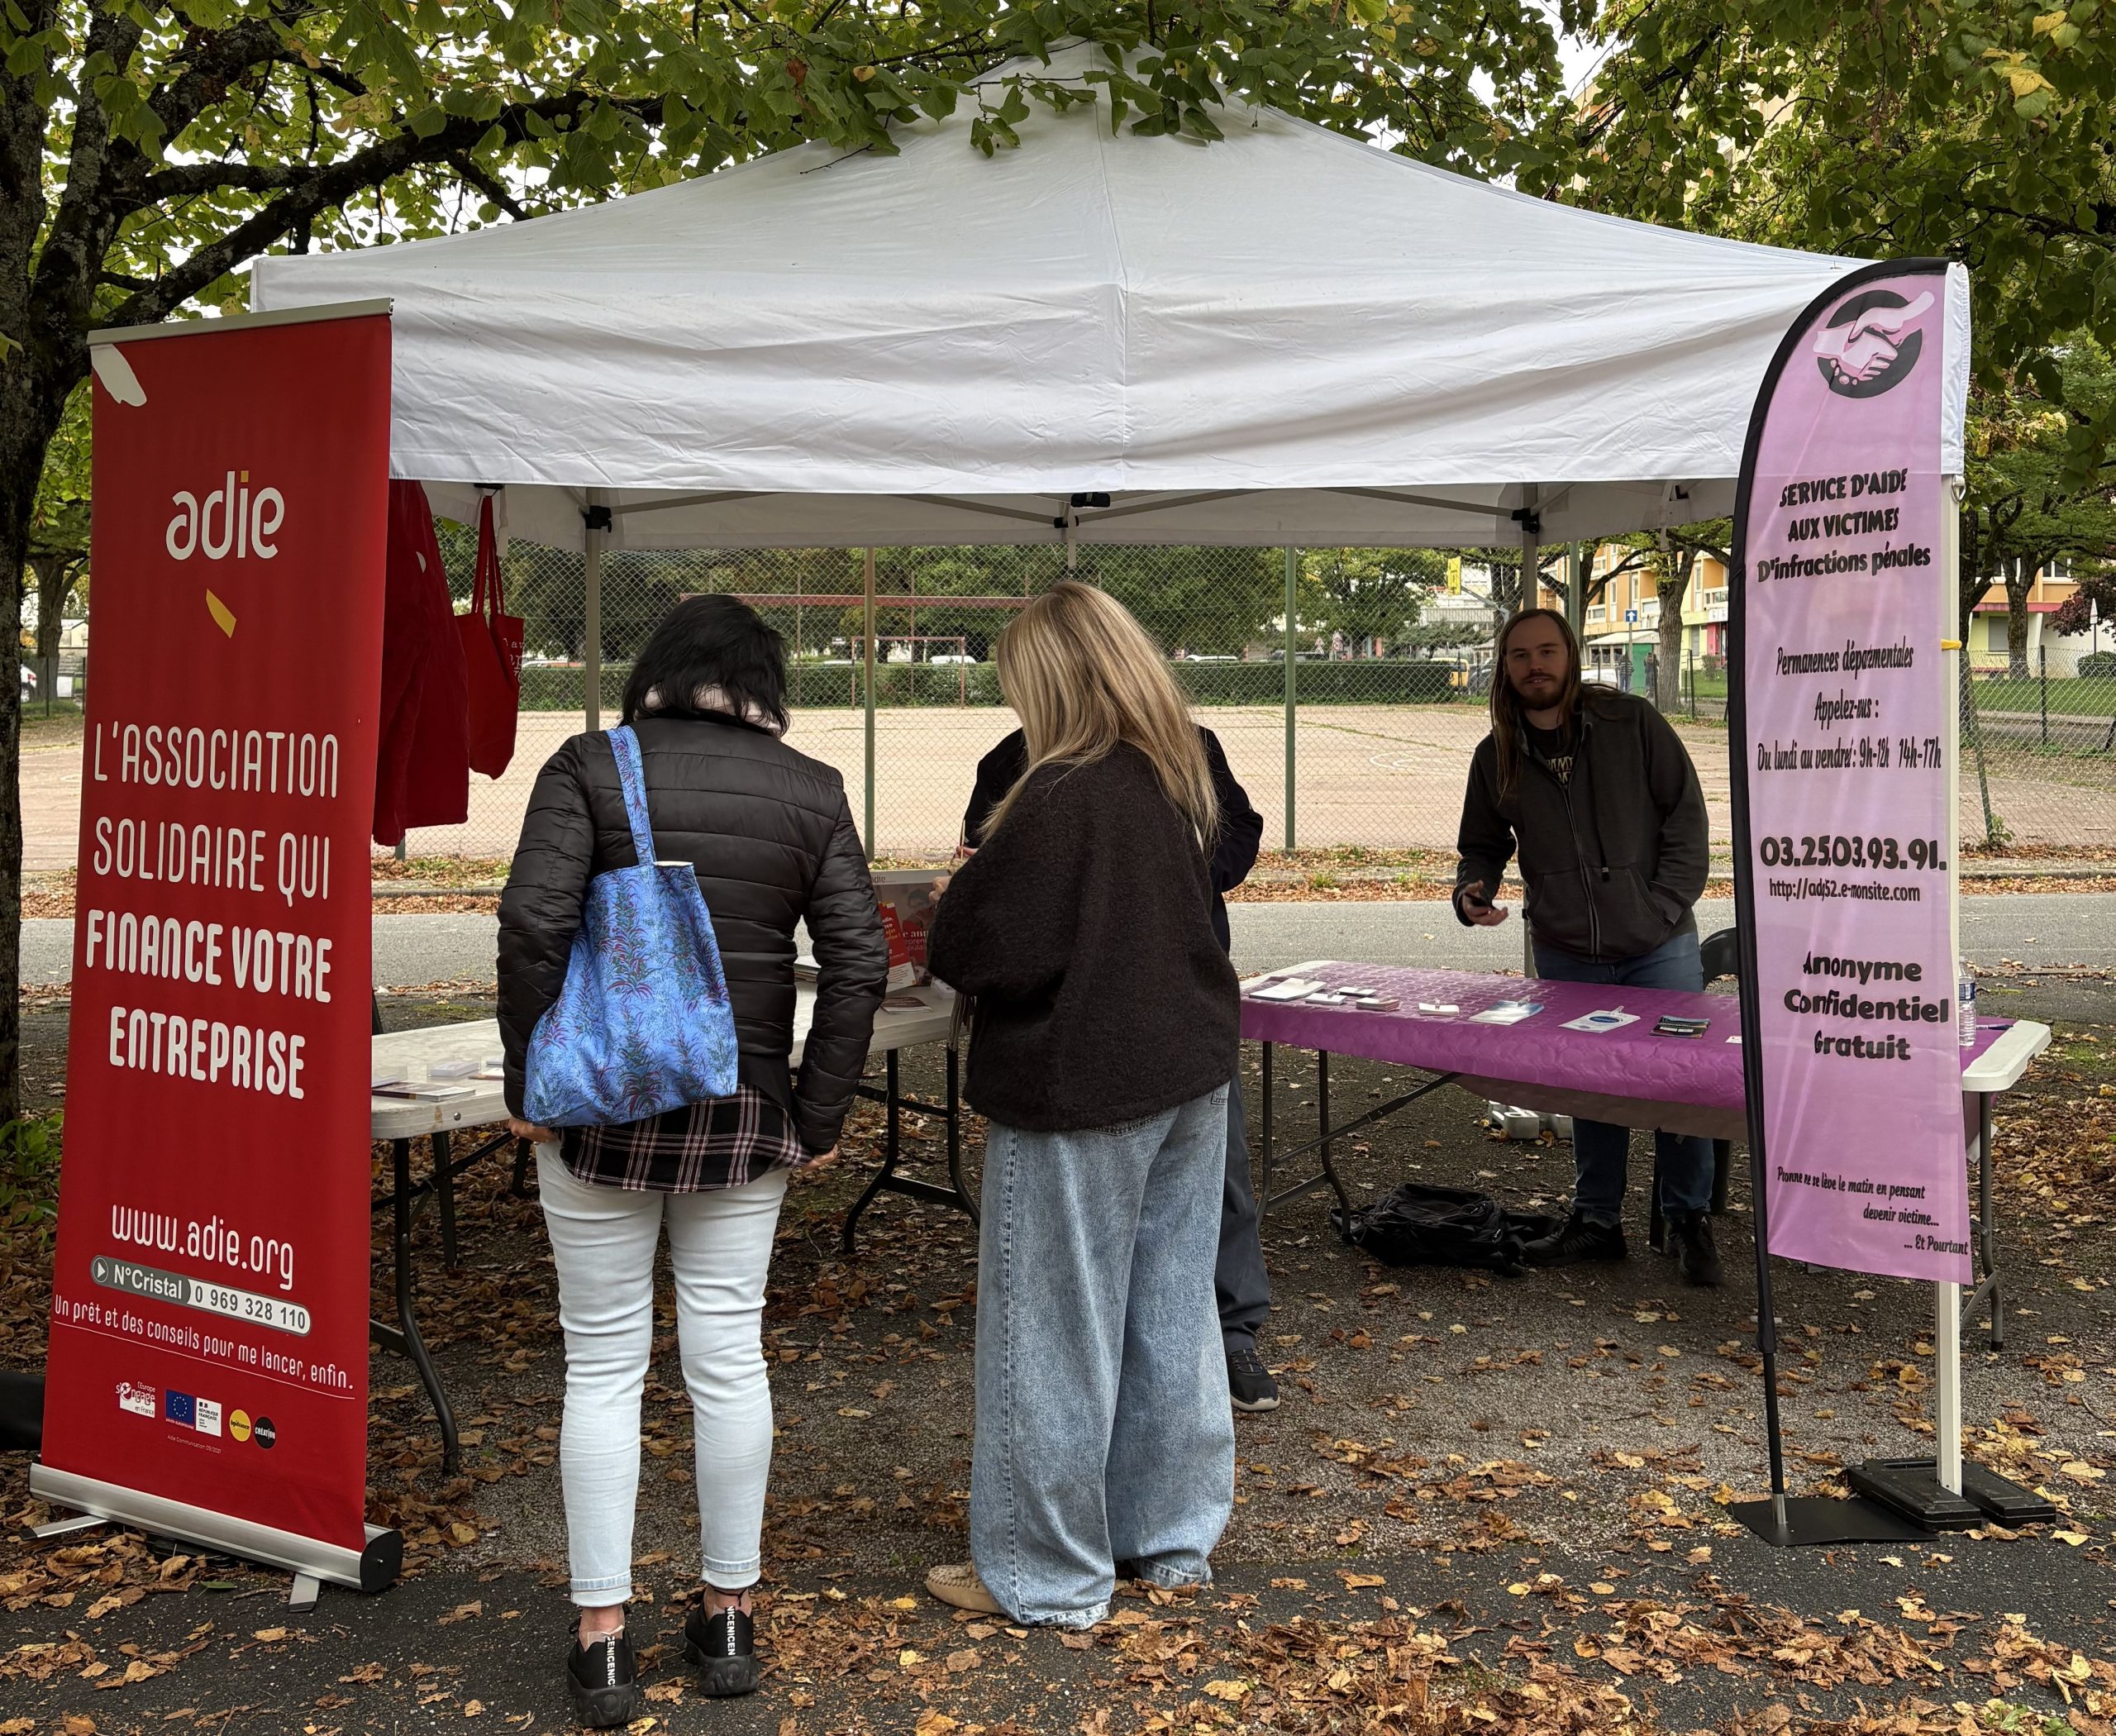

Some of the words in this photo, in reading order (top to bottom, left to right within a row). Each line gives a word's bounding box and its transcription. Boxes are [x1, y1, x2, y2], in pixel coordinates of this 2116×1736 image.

[1780, 476, 1847, 508] SERVICE
[1851, 468, 1908, 498] D'AIDE
[166, 471, 284, 560] adie
[1788, 517, 1820, 542] AUX
[1823, 508, 1899, 537] VICTIMES
[1757, 550, 1867, 582] D'infractions
[1872, 541, 1930, 575] pénales
[95, 722, 337, 798] L'ASSOCIATION
[1758, 743, 1771, 770] Du
[1775, 740, 1797, 770] lundi
[1800, 750, 1813, 769] au
[1899, 736, 1941, 768] 14h-17h
[94, 817, 265, 891] SOLIDAIRE
[279, 832, 329, 907] QUI
[87, 909, 222, 985] FINANCE
[232, 927, 331, 1003] VOTRE
[1803, 951, 1922, 985] Anonyme
[1785, 990, 1948, 1023] Confidentiel
[110, 1007, 305, 1099] ENTREPRISE
[1814, 1030, 1911, 1061] Gratuit
[1812, 1173, 1820, 1188] se
[1821, 1172, 1836, 1190] lève
[1837, 1176, 1846, 1192] le
[1848, 1179, 1874, 1194] matin
[1876, 1184, 1886, 1195] en
[1889, 1185, 1925, 1201] pensant
[1863, 1203, 1896, 1221] devenir
[1899, 1209, 1939, 1226] victime...
[112, 1204, 293, 1290] www.adie.org
[1927, 1236, 1968, 1255] Pourtant
[114, 1265, 182, 1299] N°Cristal
[195, 1285, 203, 1304] 0
[210, 1290, 238, 1311] 969
[245, 1299, 273, 1321] 328
[280, 1307, 306, 1330] 110
[55, 1295, 68, 1315] Un
[74, 1300, 101, 1323] prêt
[106, 1309, 118, 1328] et
[122, 1311, 142, 1334] des
[148, 1322, 198, 1351] conseils
[204, 1336, 233, 1357] pour
[239, 1345, 256, 1364] me
[262, 1346, 305, 1381] lancer,
[311, 1363, 354, 1390] enfin.
